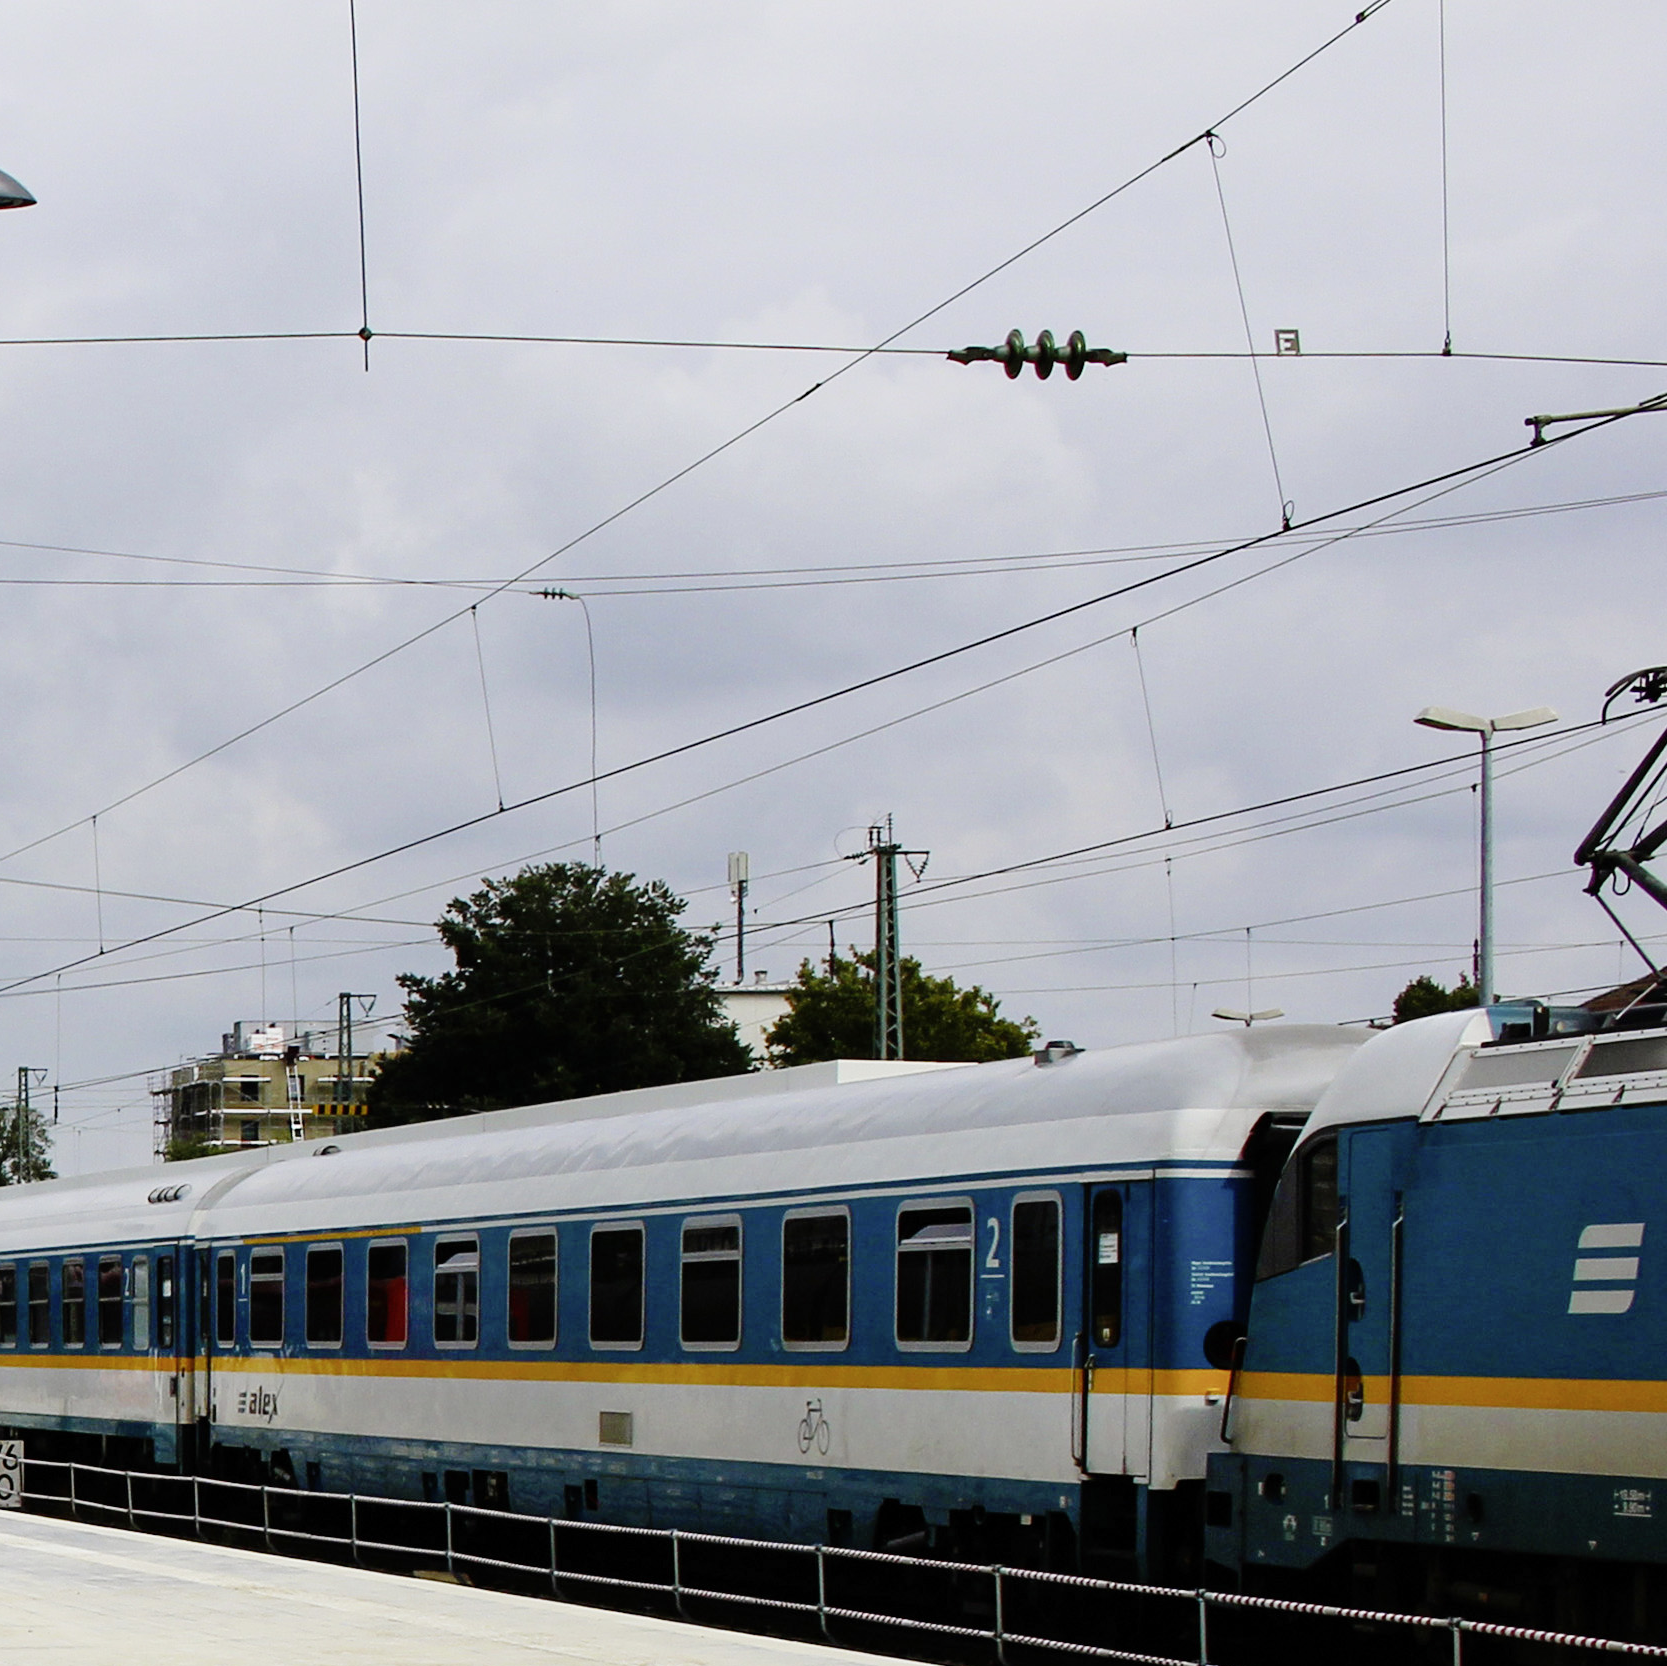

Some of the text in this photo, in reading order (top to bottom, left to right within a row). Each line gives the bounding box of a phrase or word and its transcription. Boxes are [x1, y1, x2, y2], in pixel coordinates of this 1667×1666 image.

[985, 1217, 1001, 1268] 2
[240, 1264, 246, 1295] 1
[249, 1382, 282, 1424] alex
